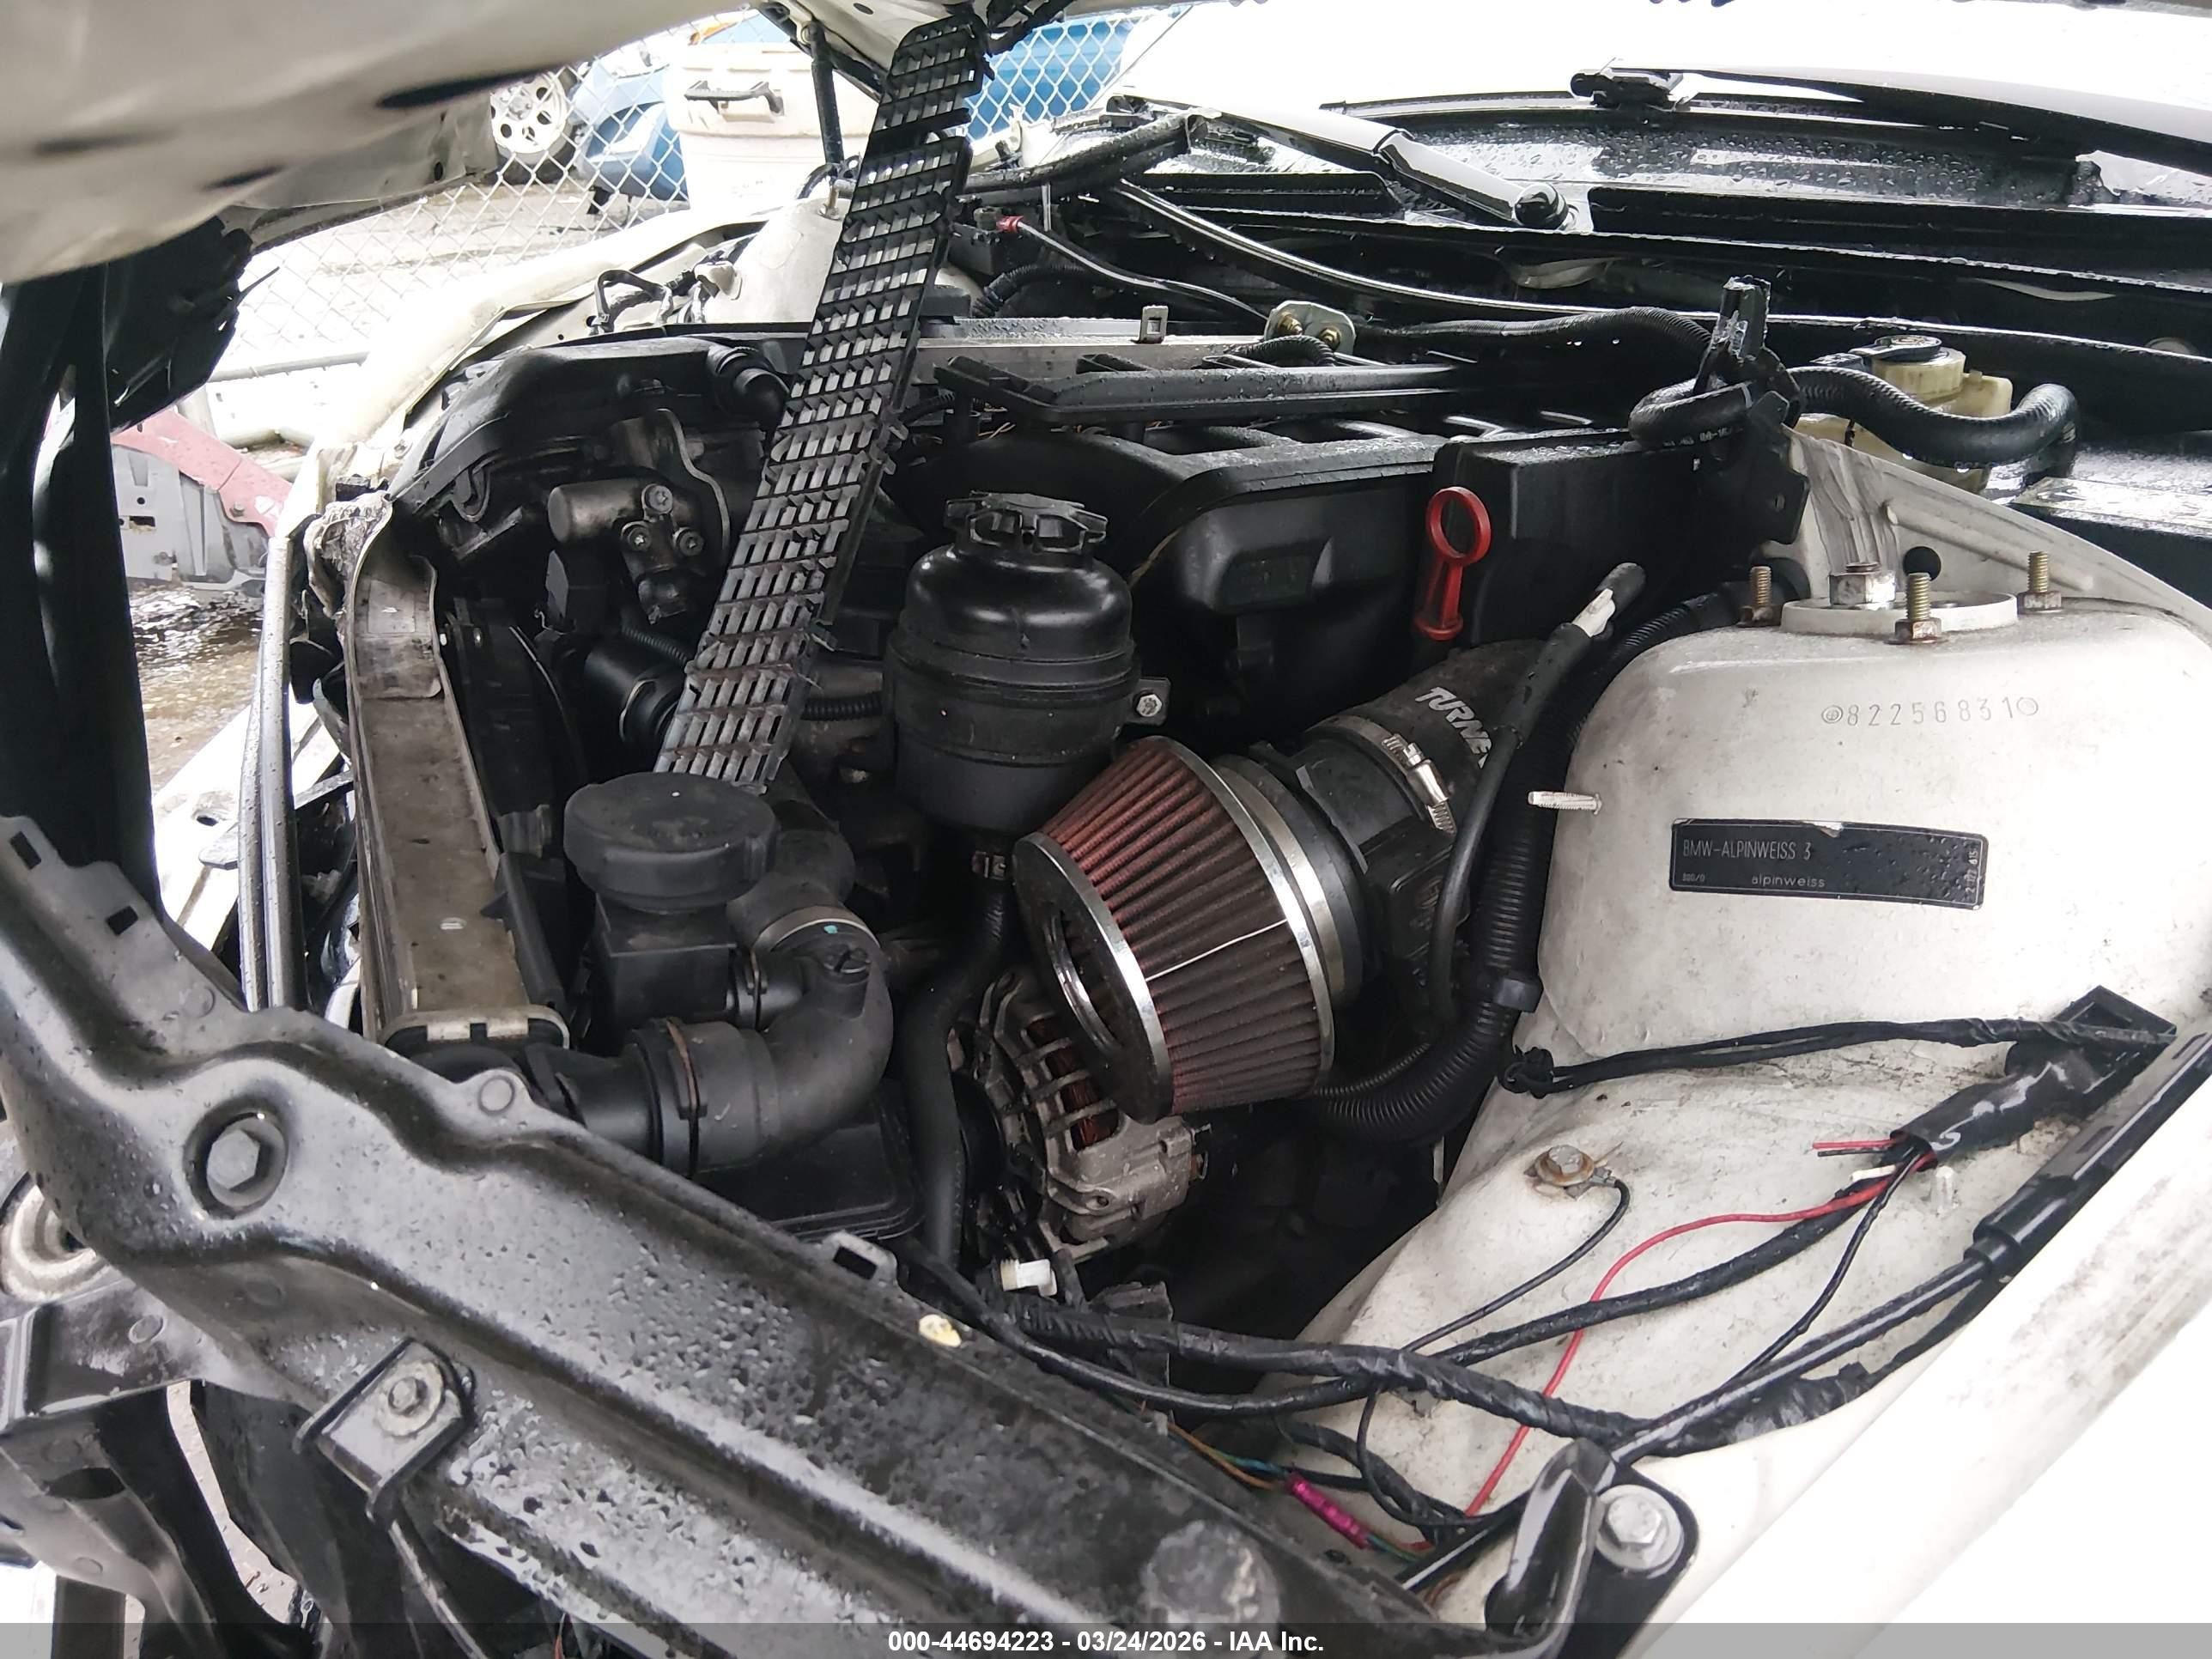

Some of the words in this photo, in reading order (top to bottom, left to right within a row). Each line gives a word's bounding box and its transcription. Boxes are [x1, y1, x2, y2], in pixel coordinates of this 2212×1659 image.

[1846, 696, 2014, 727] 82256831
[1682, 840, 1796, 860] BMW-ALPINWEISS
[1804, 842, 1813, 860] 3
[1751, 873, 1826, 888] alpinweiss
